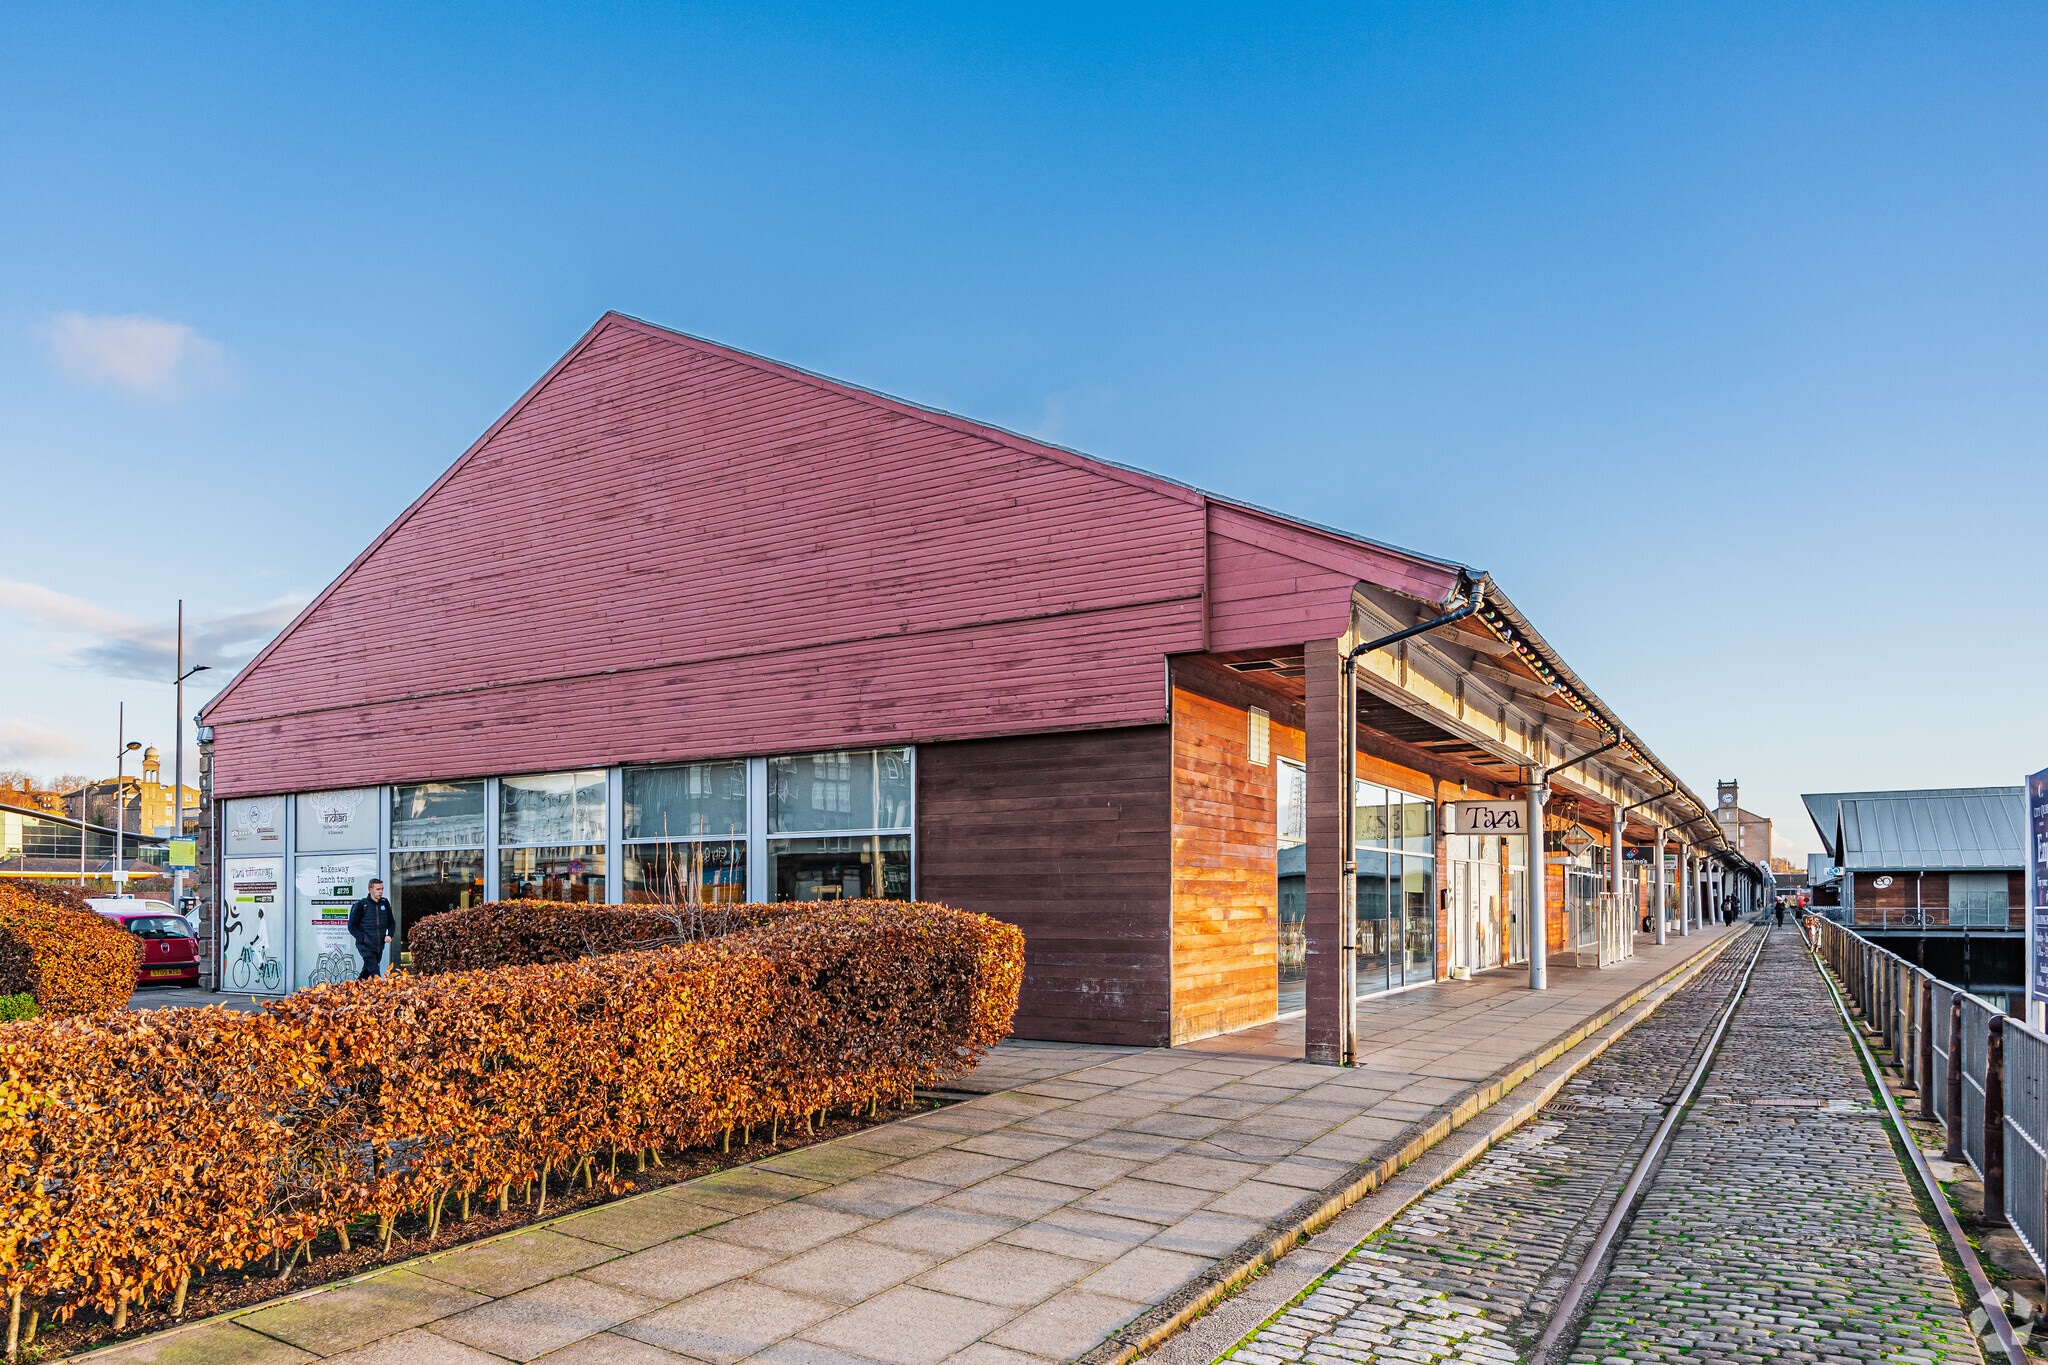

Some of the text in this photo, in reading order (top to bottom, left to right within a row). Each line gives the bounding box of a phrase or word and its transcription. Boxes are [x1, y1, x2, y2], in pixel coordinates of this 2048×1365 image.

[1465, 807, 1524, 830] Taza
[320, 865, 349, 874] takeaway
[317, 876, 355, 884] lunch trays
[318, 887, 333, 896] only
